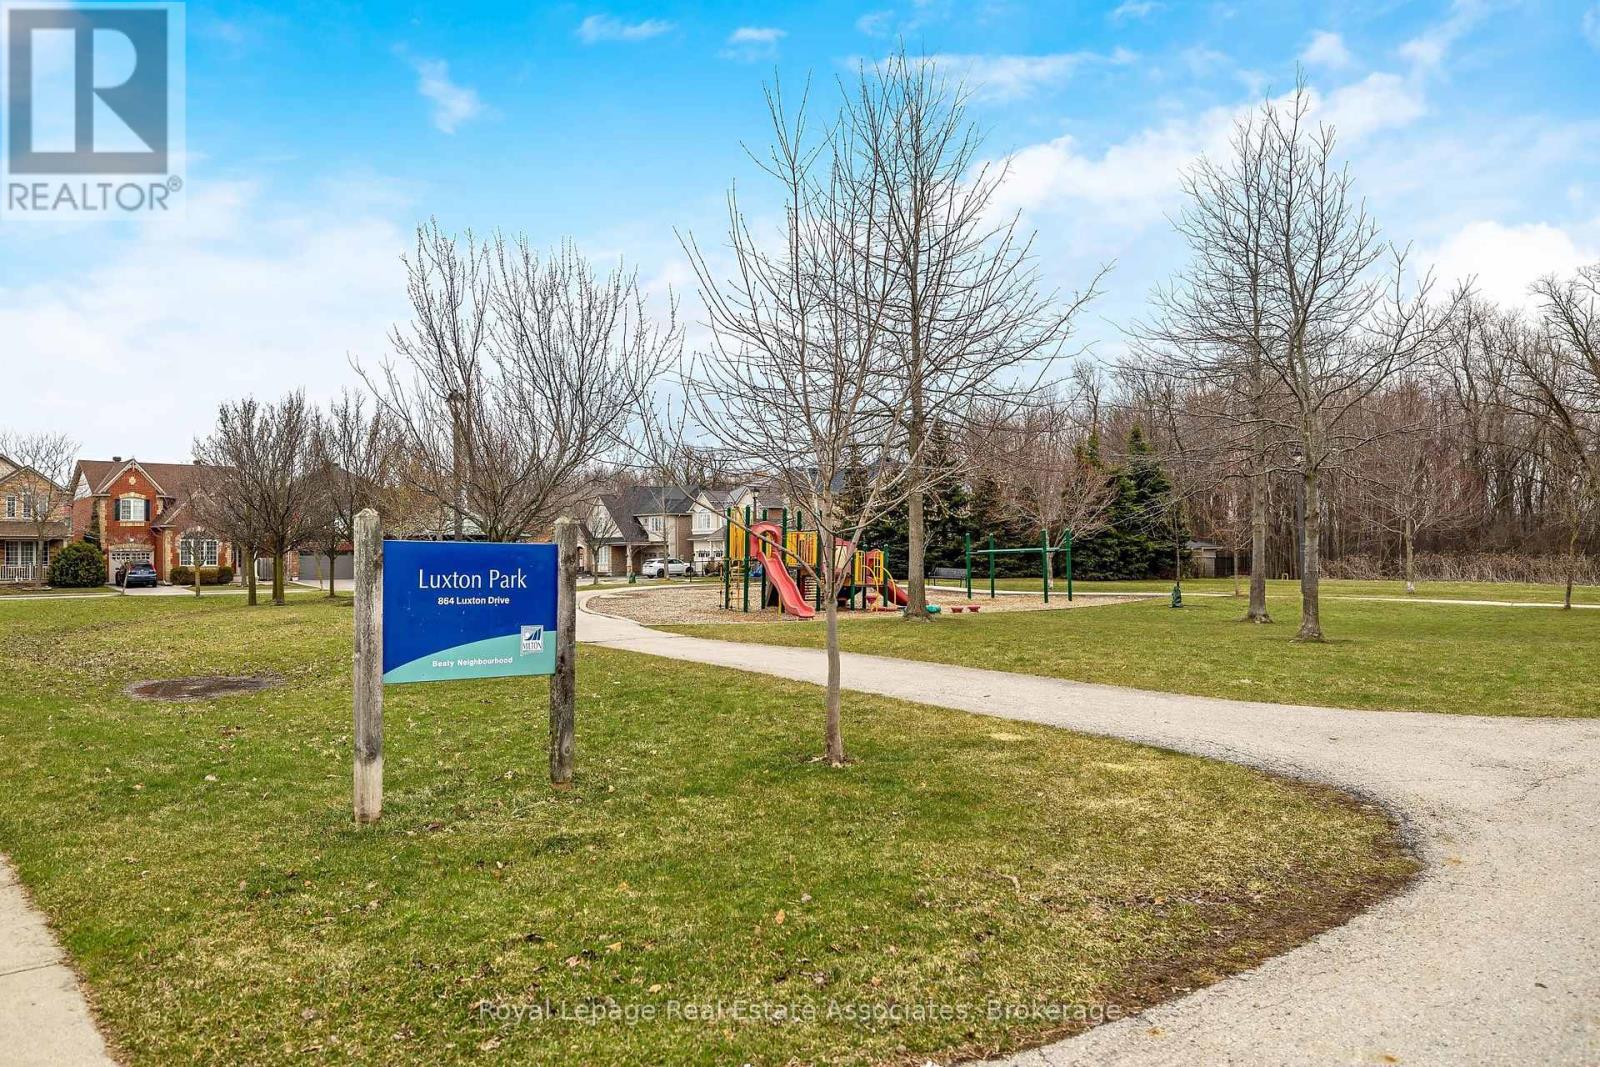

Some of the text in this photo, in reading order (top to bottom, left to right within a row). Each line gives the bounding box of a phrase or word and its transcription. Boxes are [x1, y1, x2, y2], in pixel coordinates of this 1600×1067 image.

[419, 568, 527, 589] Luxton Park
[437, 596, 510, 605] 864 Luxton Drive
[457, 657, 513, 667] Neighbourhood
